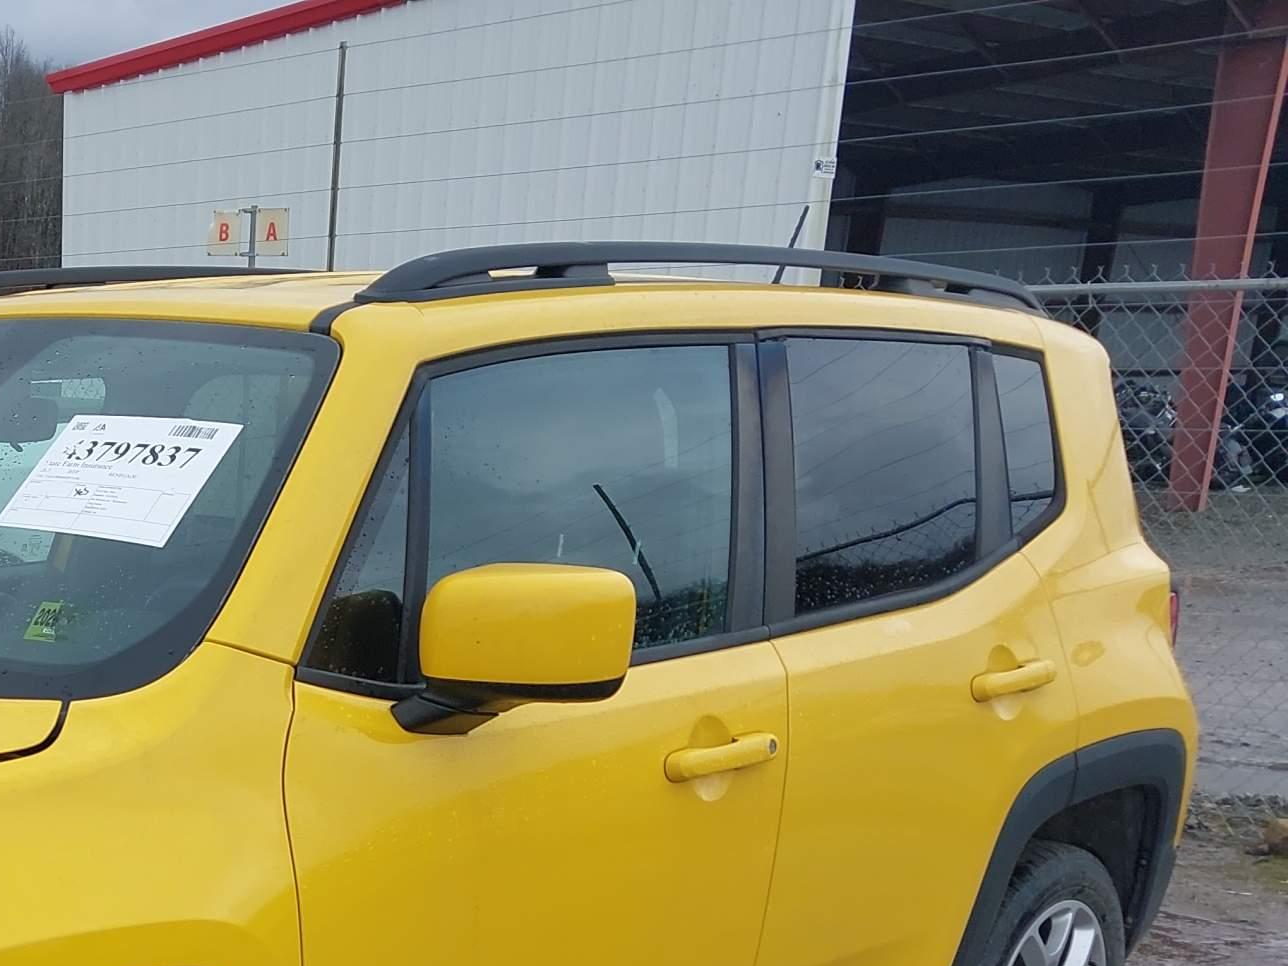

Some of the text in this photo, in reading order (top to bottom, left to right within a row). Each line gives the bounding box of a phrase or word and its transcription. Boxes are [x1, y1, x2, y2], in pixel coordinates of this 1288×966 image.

[219, 223, 230, 241] B
[266, 222, 278, 241] A
[64, 439, 202, 469] 43797837
